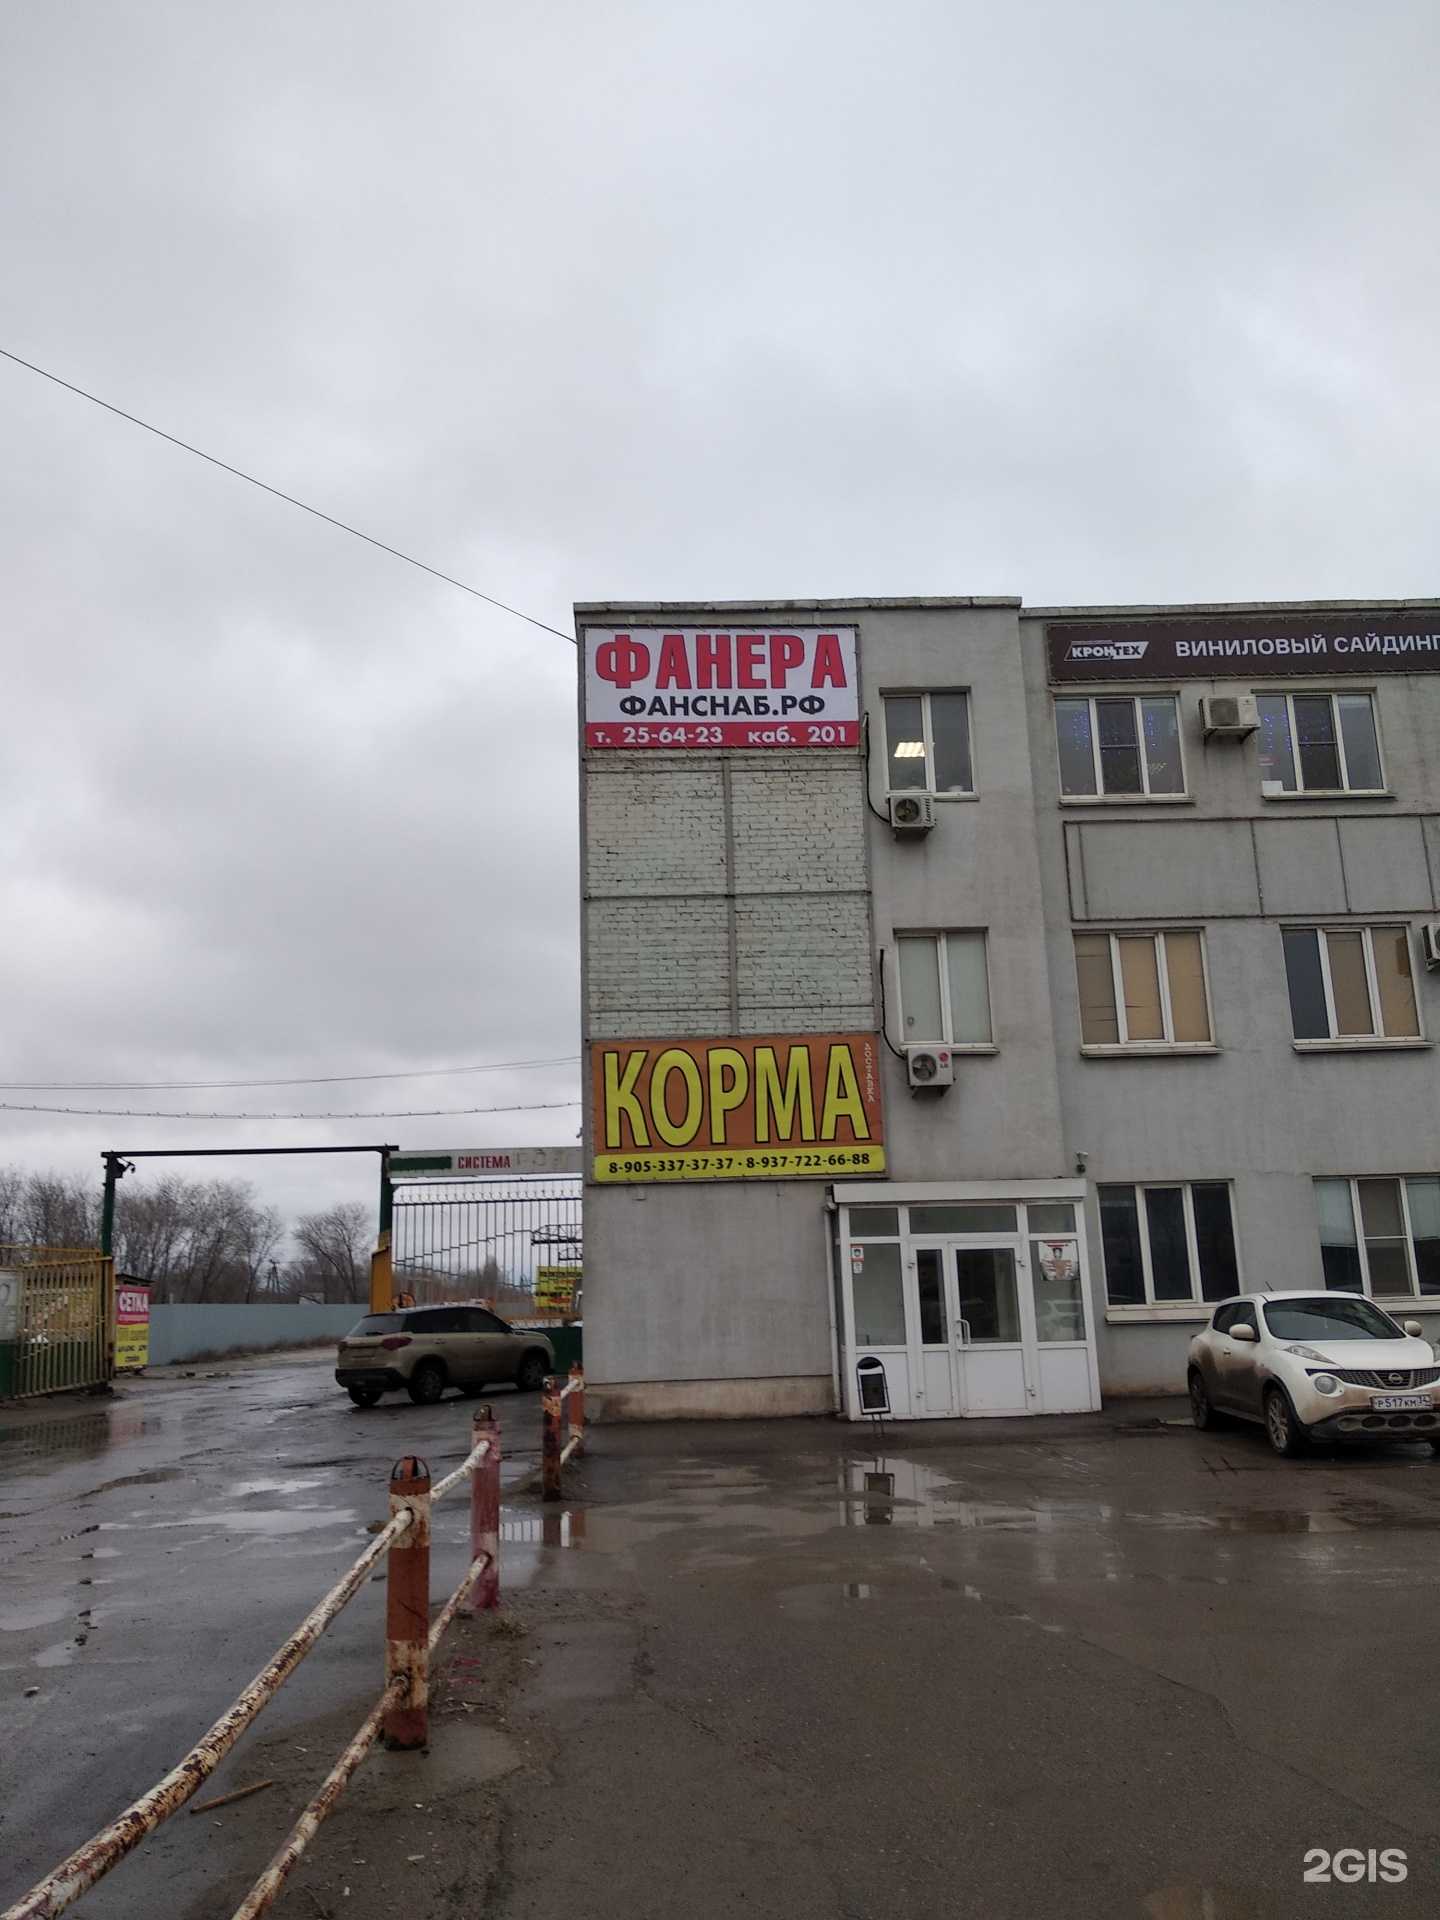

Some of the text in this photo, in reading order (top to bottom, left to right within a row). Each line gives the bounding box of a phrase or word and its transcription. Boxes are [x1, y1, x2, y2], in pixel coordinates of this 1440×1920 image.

[1071, 645, 1142, 658] КРОНТЕХ
[1175, 634, 1328, 658] ВИНИЛОВЫЙ
[595, 634, 848, 690] ФАНЕРА
[619, 695, 826, 716] ФАНСНАБ.РФ
[595, 726, 847, 744] т. 25-64-23 каб. 201
[603, 1044, 872, 1149] КОРМА
[457, 1155, 512, 1169] СИСТЕМА
[608, 1153, 870, 1173] 8-905-337-37-37 8-937-722-66-88
[119, 1291, 149, 1312] СЕТКА
